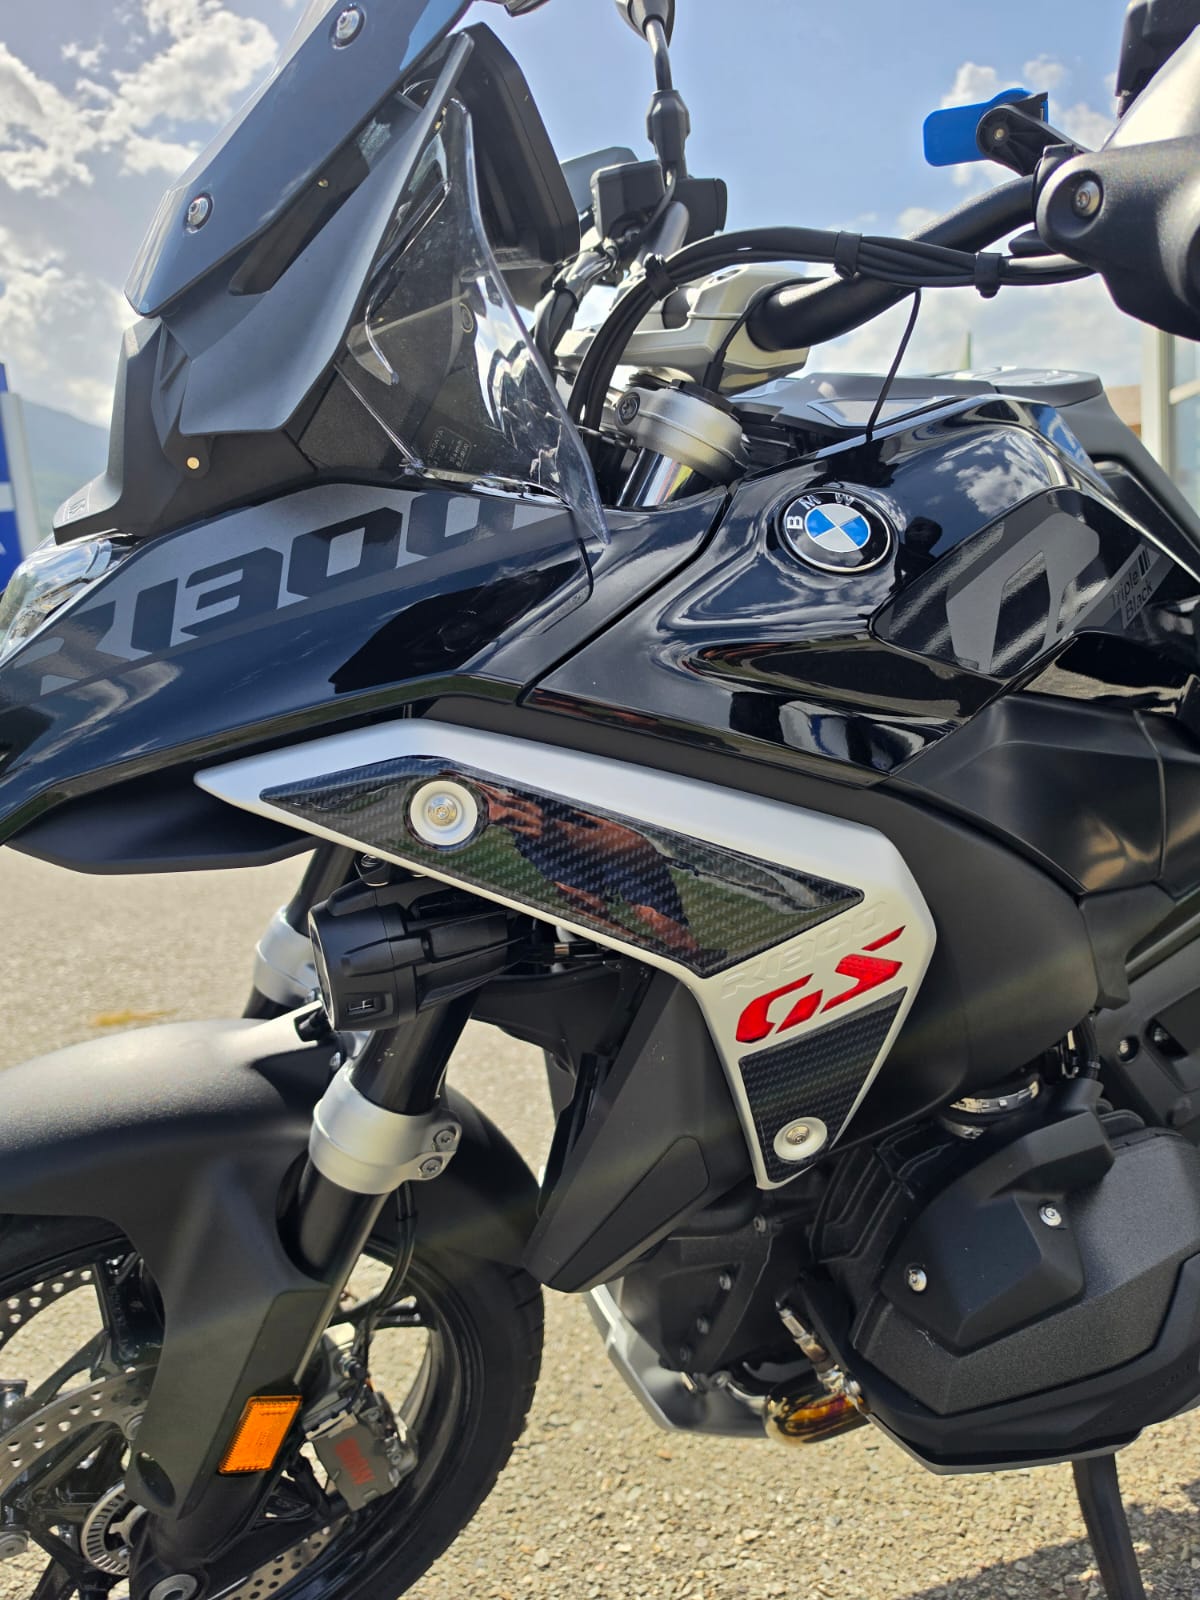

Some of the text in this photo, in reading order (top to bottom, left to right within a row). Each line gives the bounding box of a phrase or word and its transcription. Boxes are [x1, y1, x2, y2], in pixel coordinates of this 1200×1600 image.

[786, 492, 855, 530] BMW
[1110, 571, 1139, 610] Triple
[1125, 579, 1153, 621] Black
[735, 924, 907, 1044] GS
